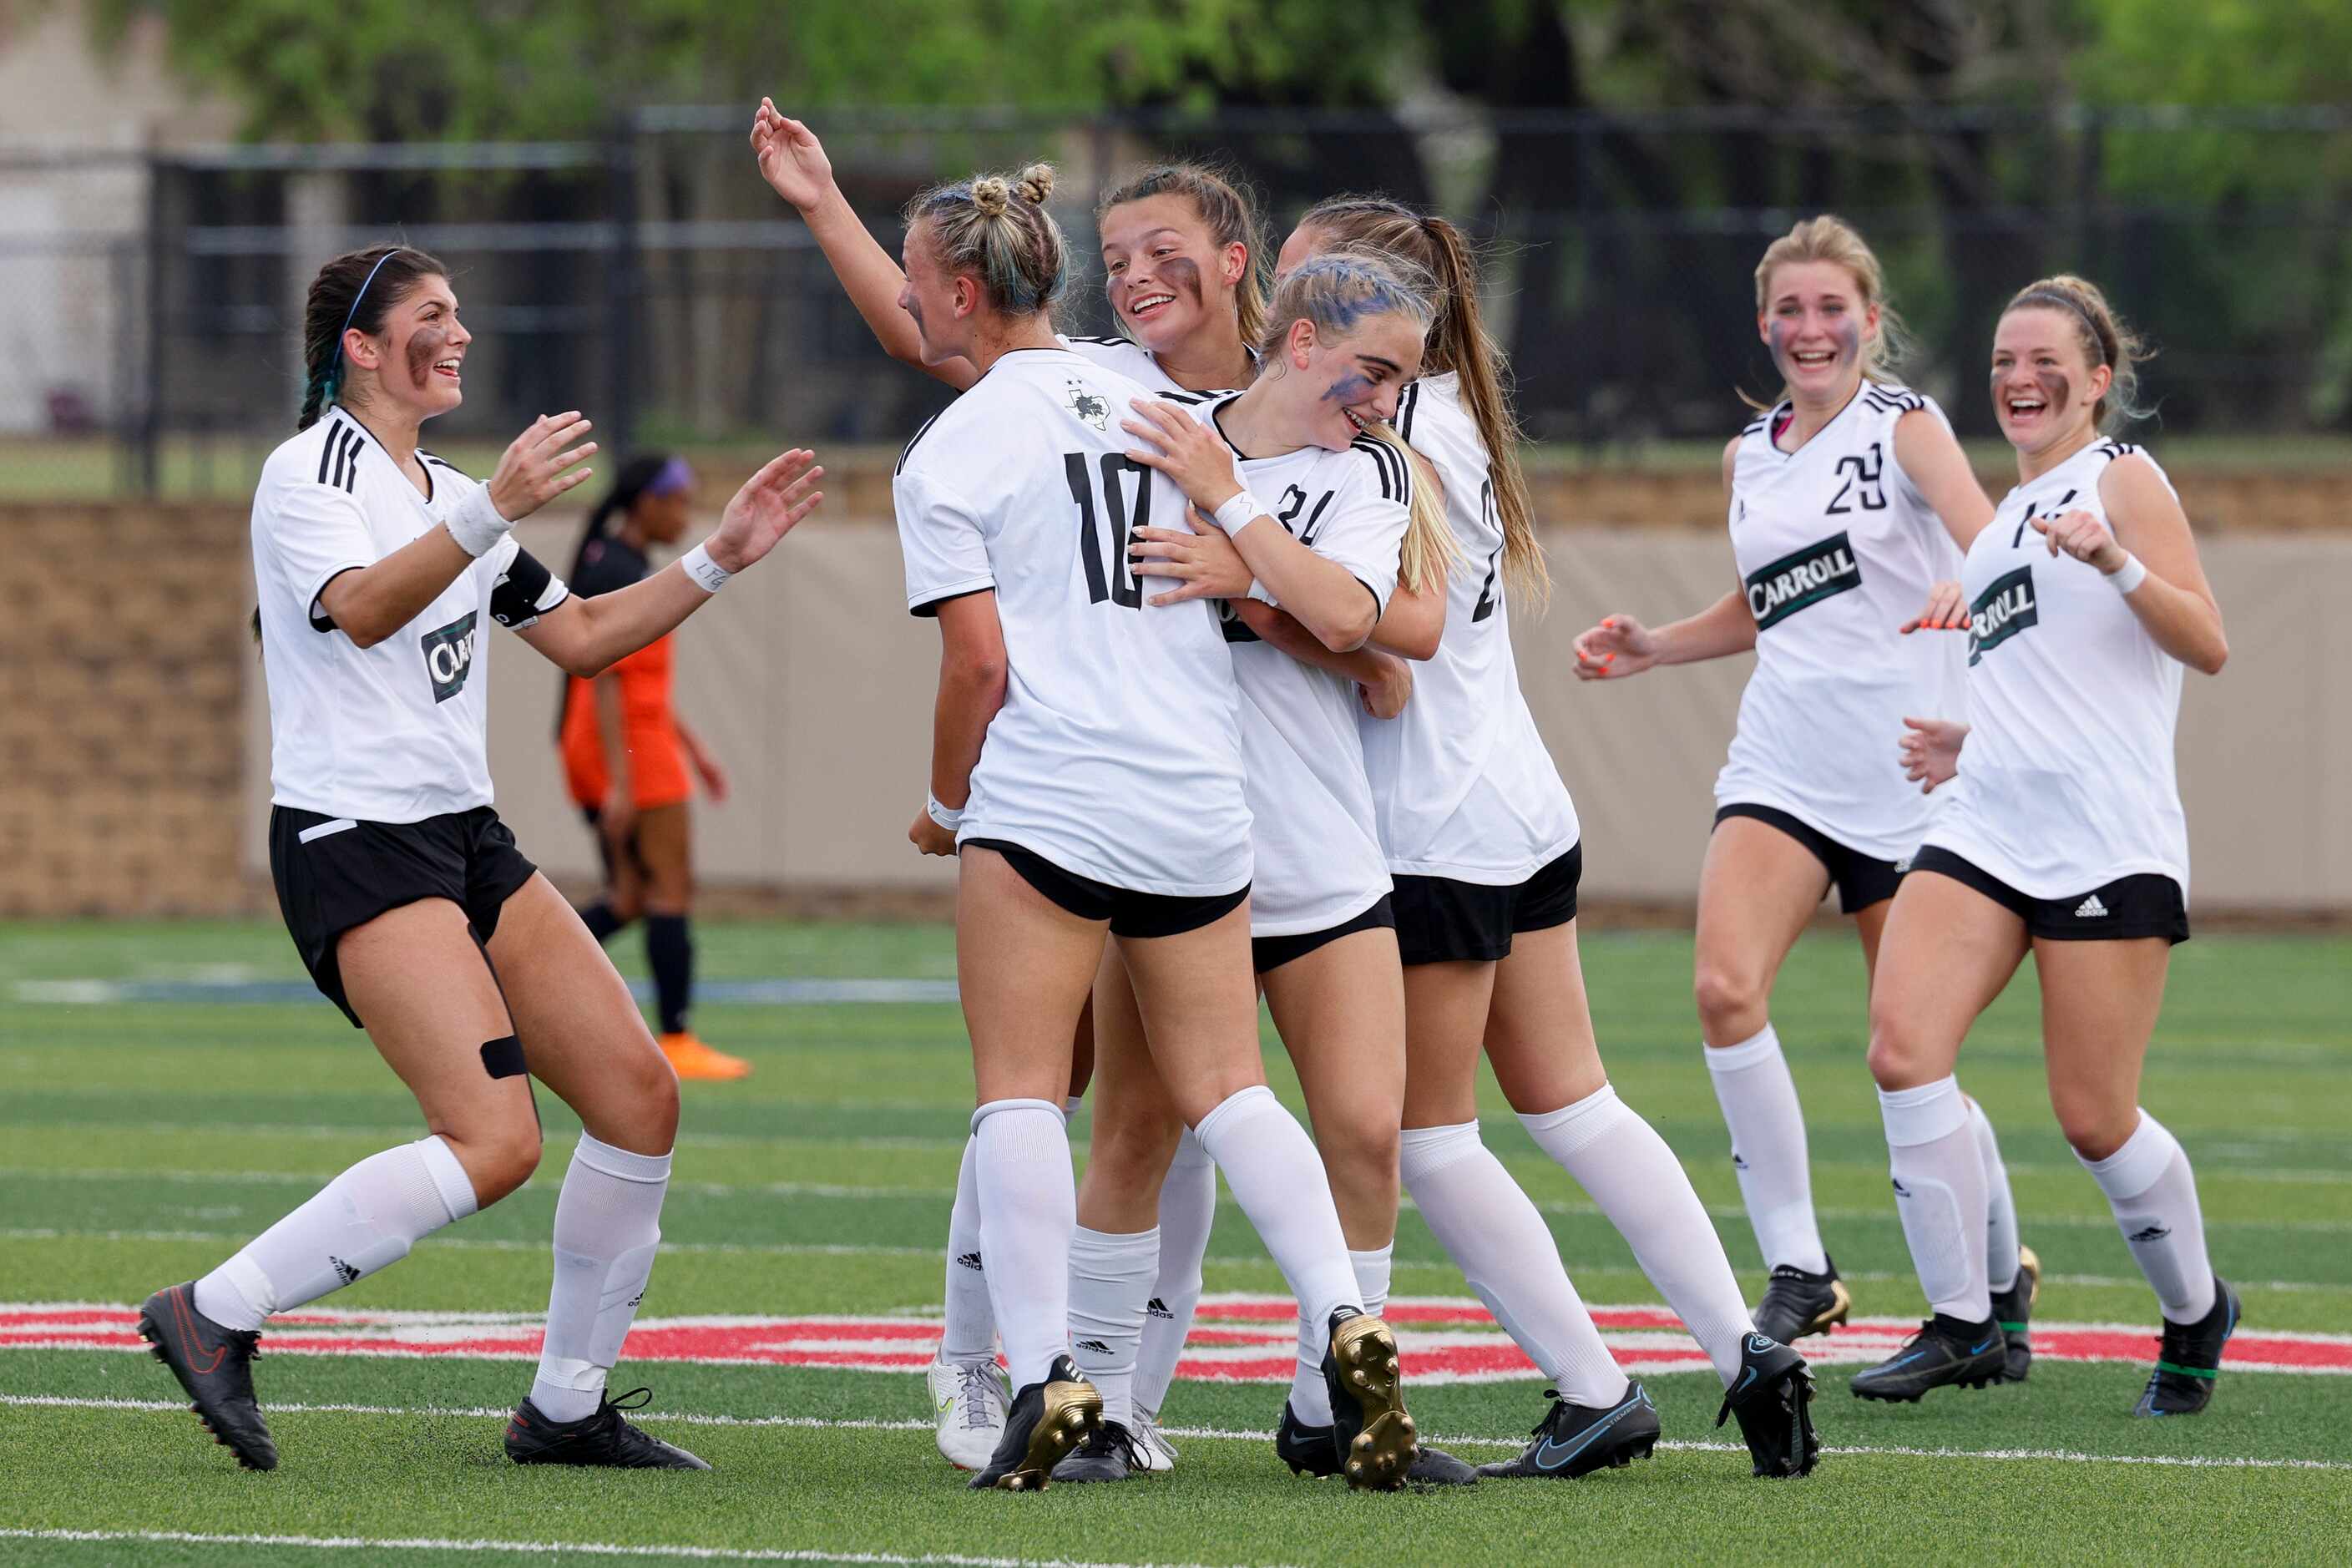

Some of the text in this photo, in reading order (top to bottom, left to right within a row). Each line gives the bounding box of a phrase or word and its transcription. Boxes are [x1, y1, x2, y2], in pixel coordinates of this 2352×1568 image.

[1825, 443, 1887, 515] 29
[1064, 451, 1151, 611] 10
[1748, 548, 1857, 621] CARROLL
[2075, 908, 2108, 918] adidas
[1148, 1308, 1175, 1319] idas
[1076, 1343, 1115, 1355] adidas
[1610, 1404, 1637, 1425] TIEMPO
